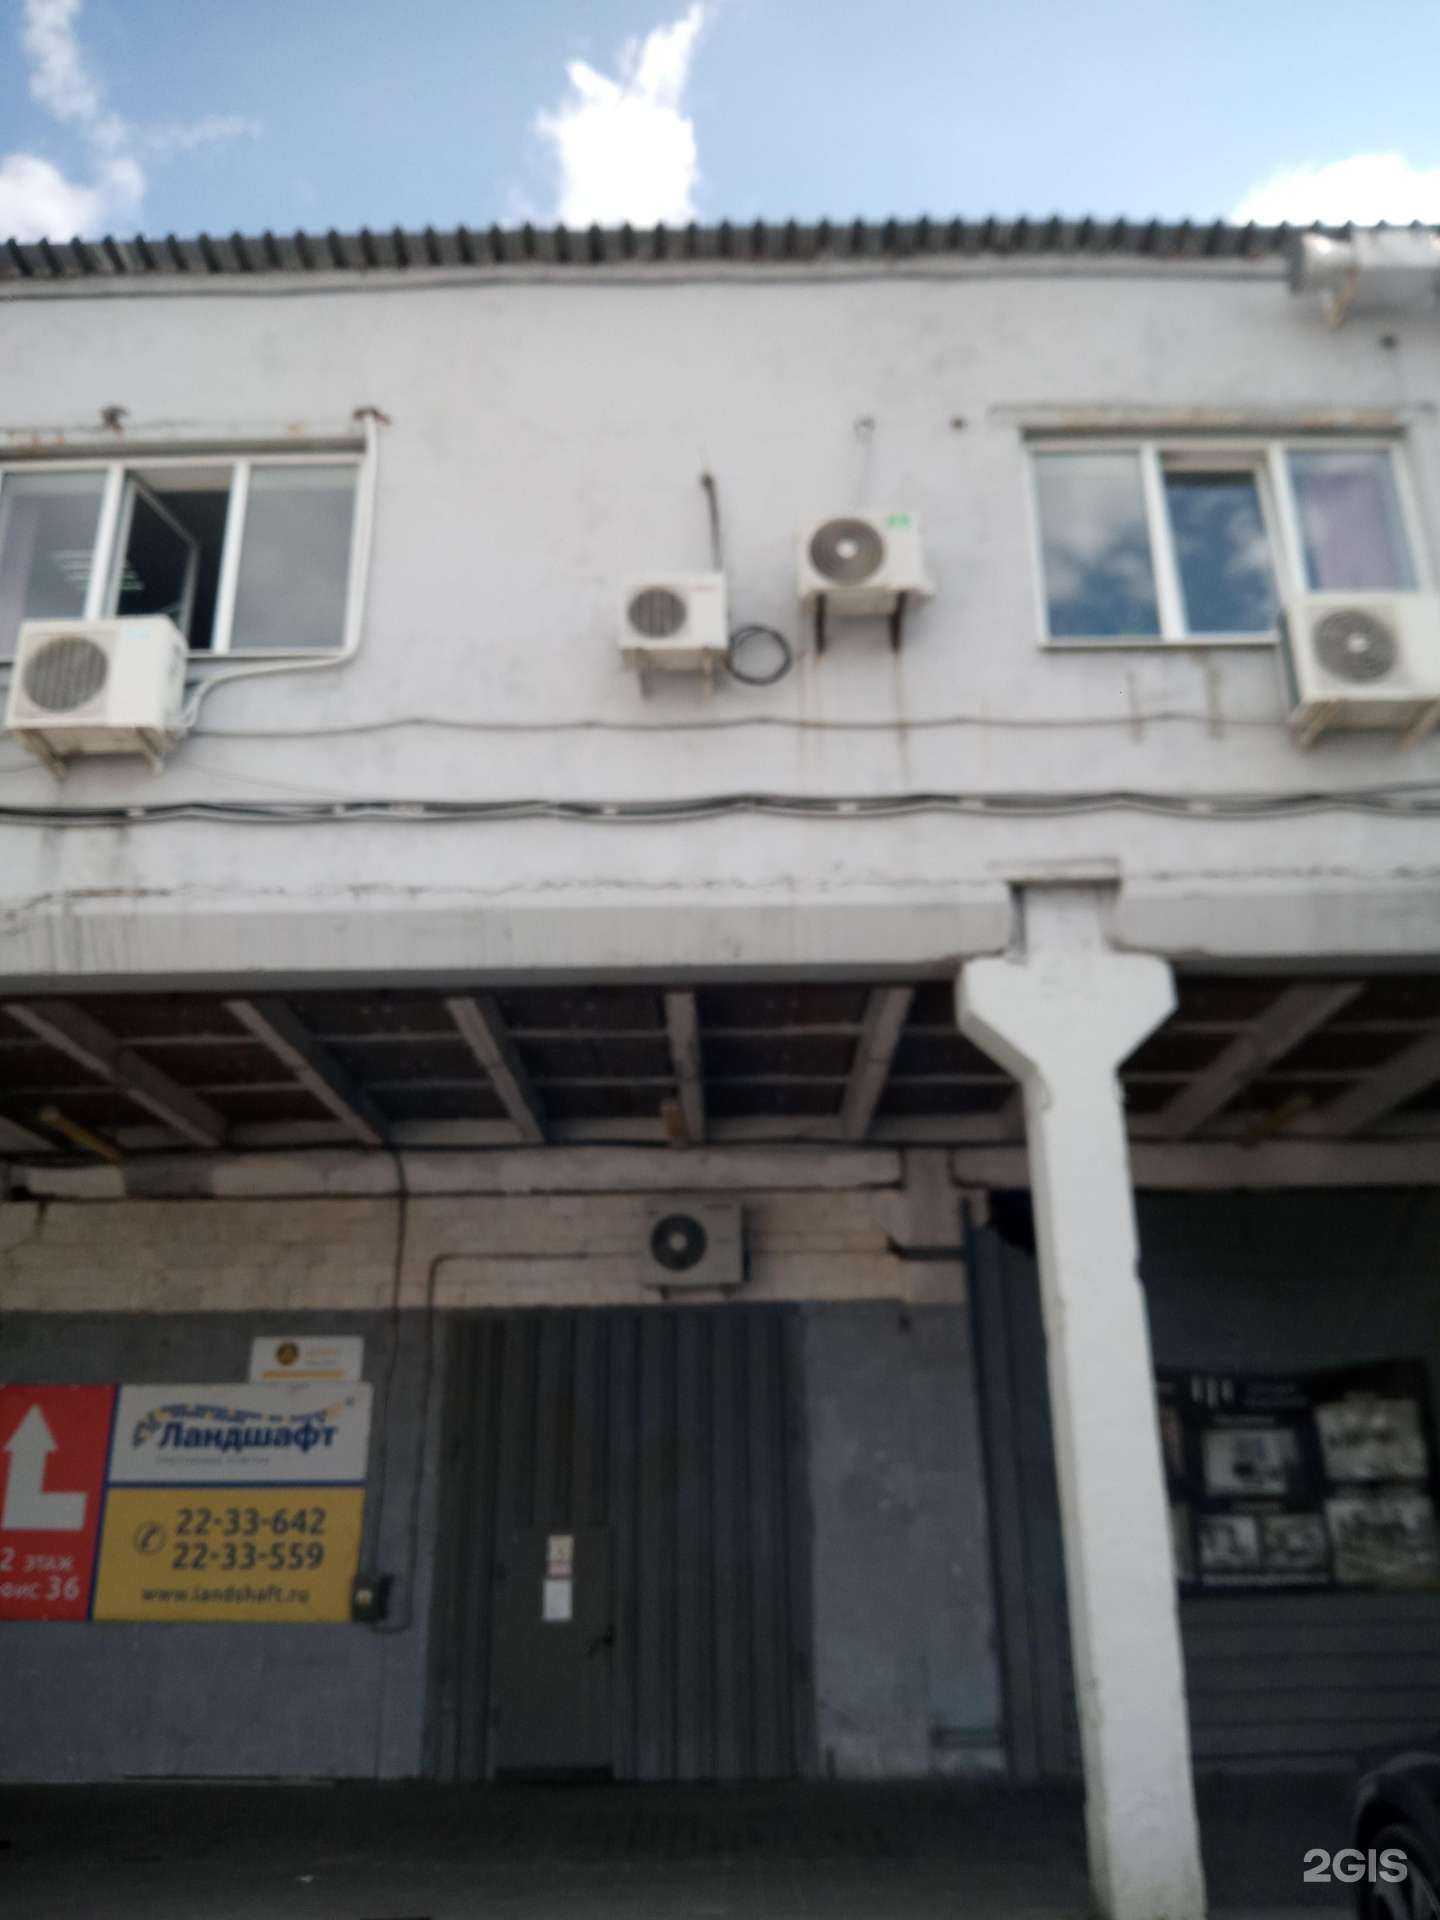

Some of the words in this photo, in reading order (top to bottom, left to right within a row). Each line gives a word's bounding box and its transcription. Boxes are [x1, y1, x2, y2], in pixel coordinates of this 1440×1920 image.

[158, 1420, 339, 1453] Ландшафт
[175, 1505, 328, 1537] 22-33-642
[0, 1546, 16, 1571] 2
[172, 1540, 326, 1571] 22-33-559
[0, 1581, 40, 1601] фис
[45, 1575, 80, 1602] 36
